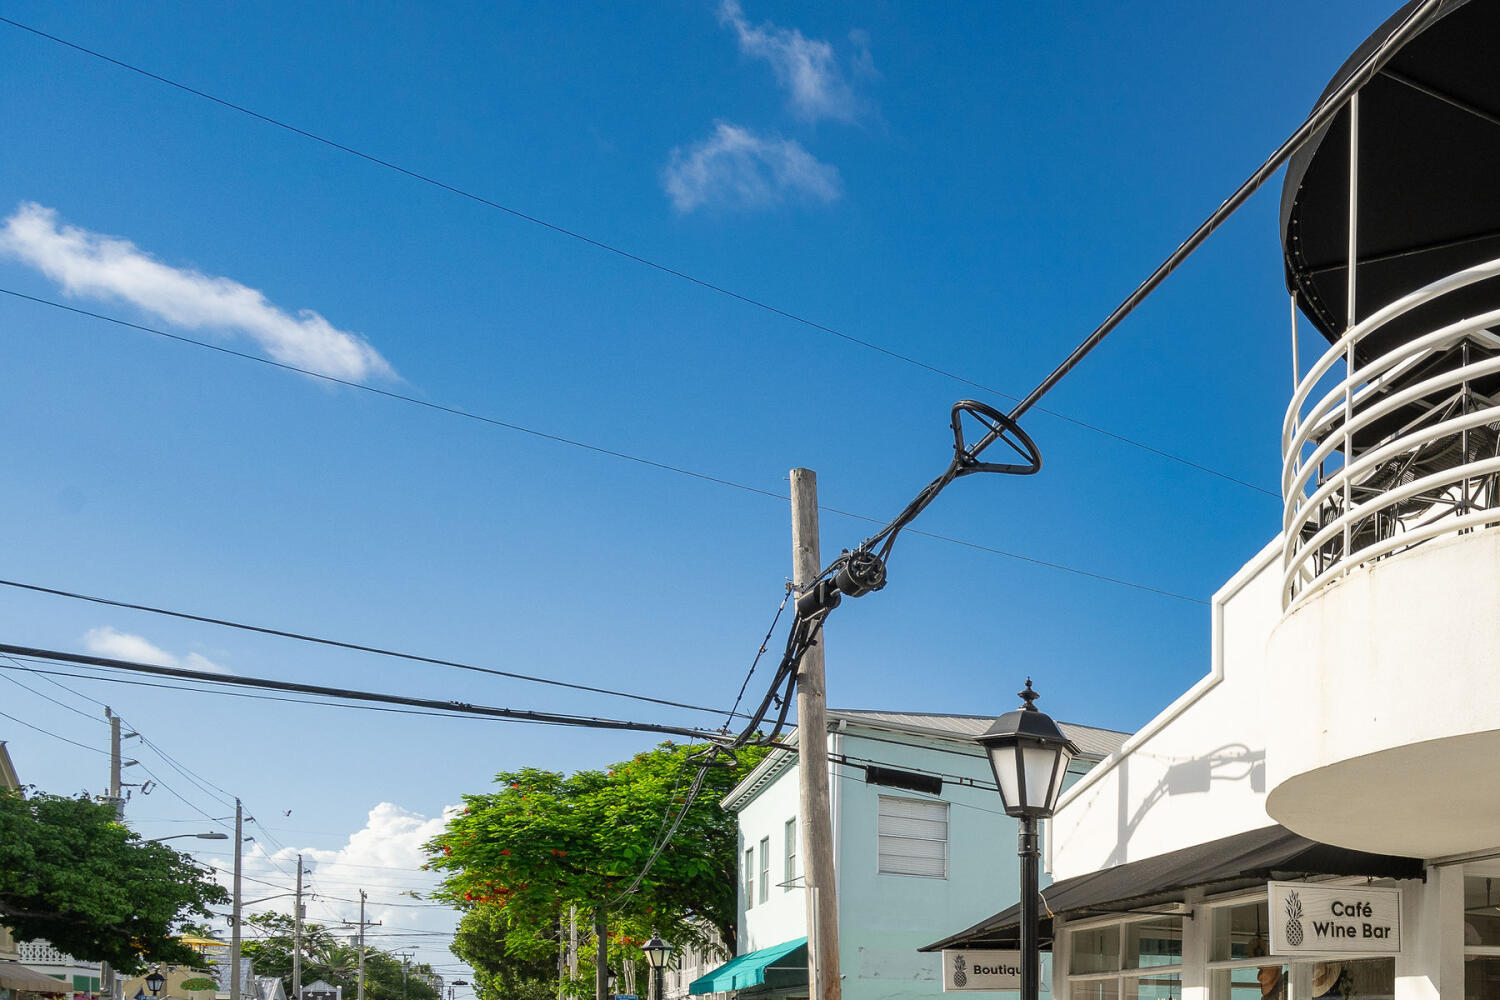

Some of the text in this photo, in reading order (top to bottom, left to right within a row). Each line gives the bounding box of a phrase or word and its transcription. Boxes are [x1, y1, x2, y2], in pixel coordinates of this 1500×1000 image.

[1331, 901, 1373, 918] Café
[1312, 921, 1391, 939] Wine Bar
[974, 965, 1020, 976] Boutiqu
